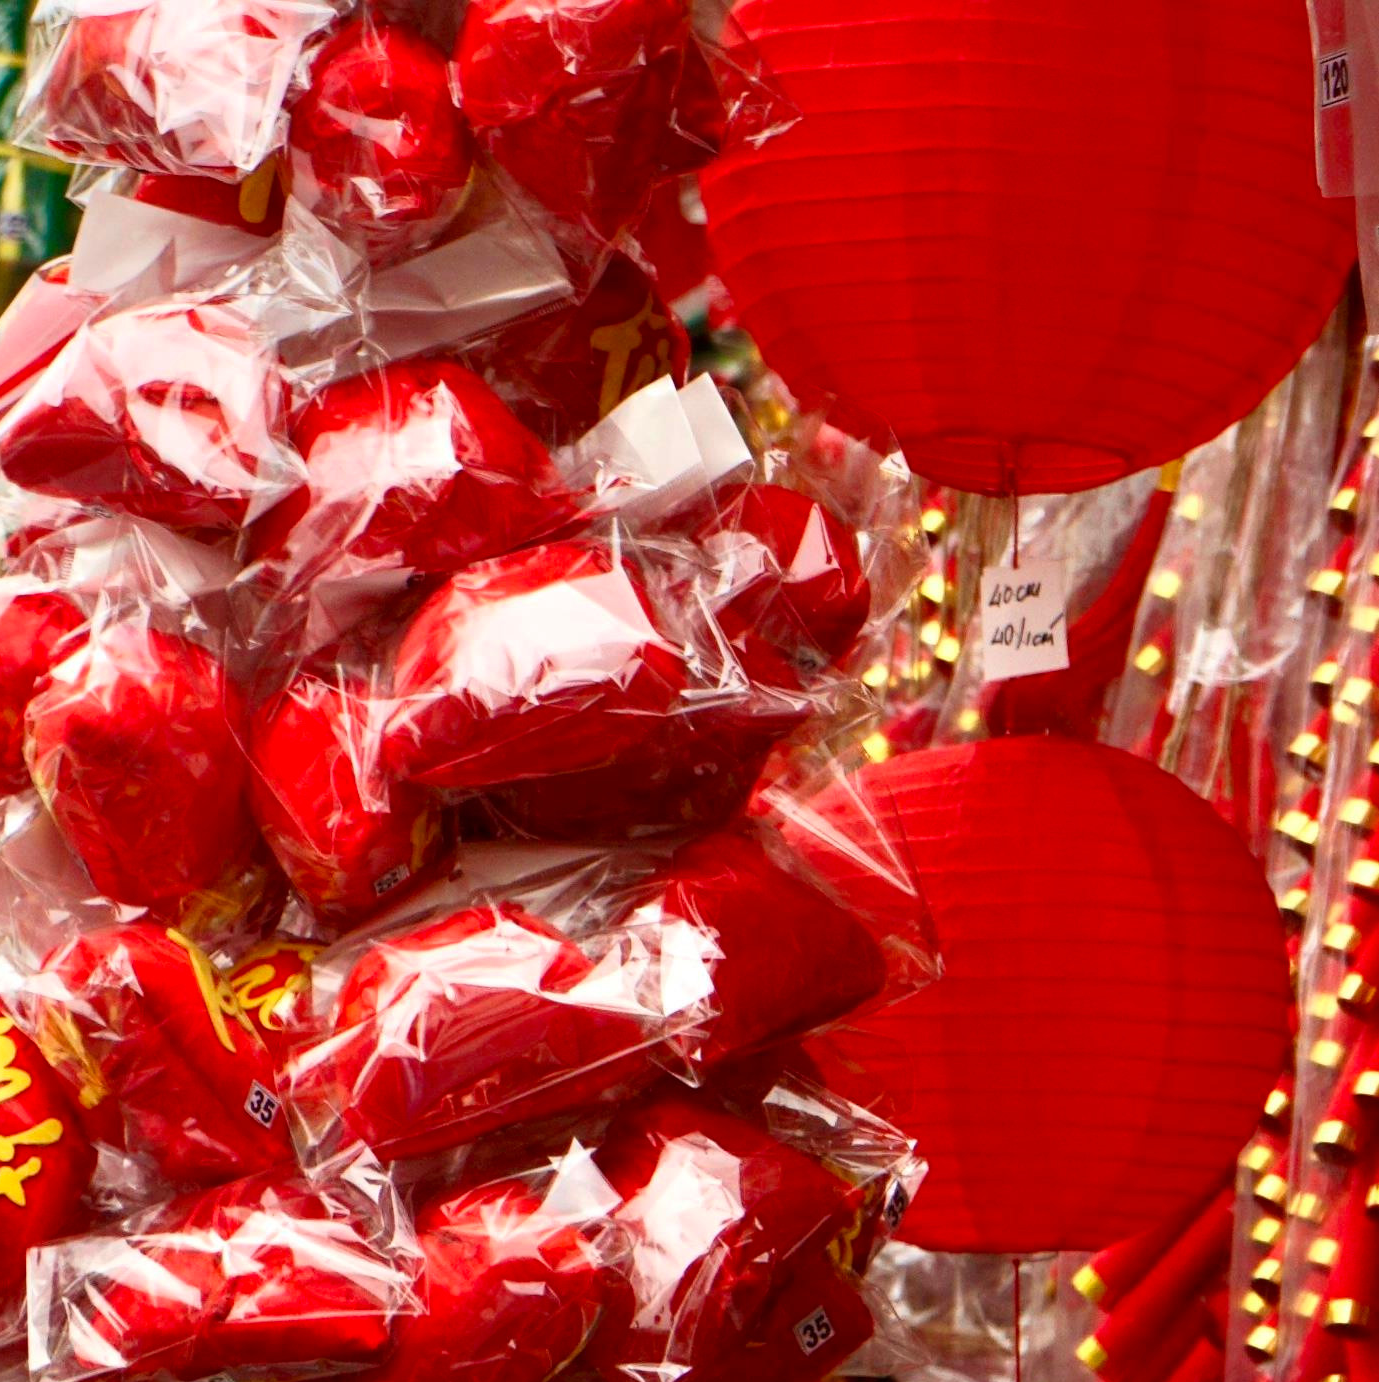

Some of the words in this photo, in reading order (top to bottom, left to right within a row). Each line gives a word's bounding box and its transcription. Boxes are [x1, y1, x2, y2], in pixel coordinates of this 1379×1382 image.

[1323, 59, 1349, 100] 120
[250, 1090, 275, 1124] 35
[803, 1314, 831, 1348] 35
